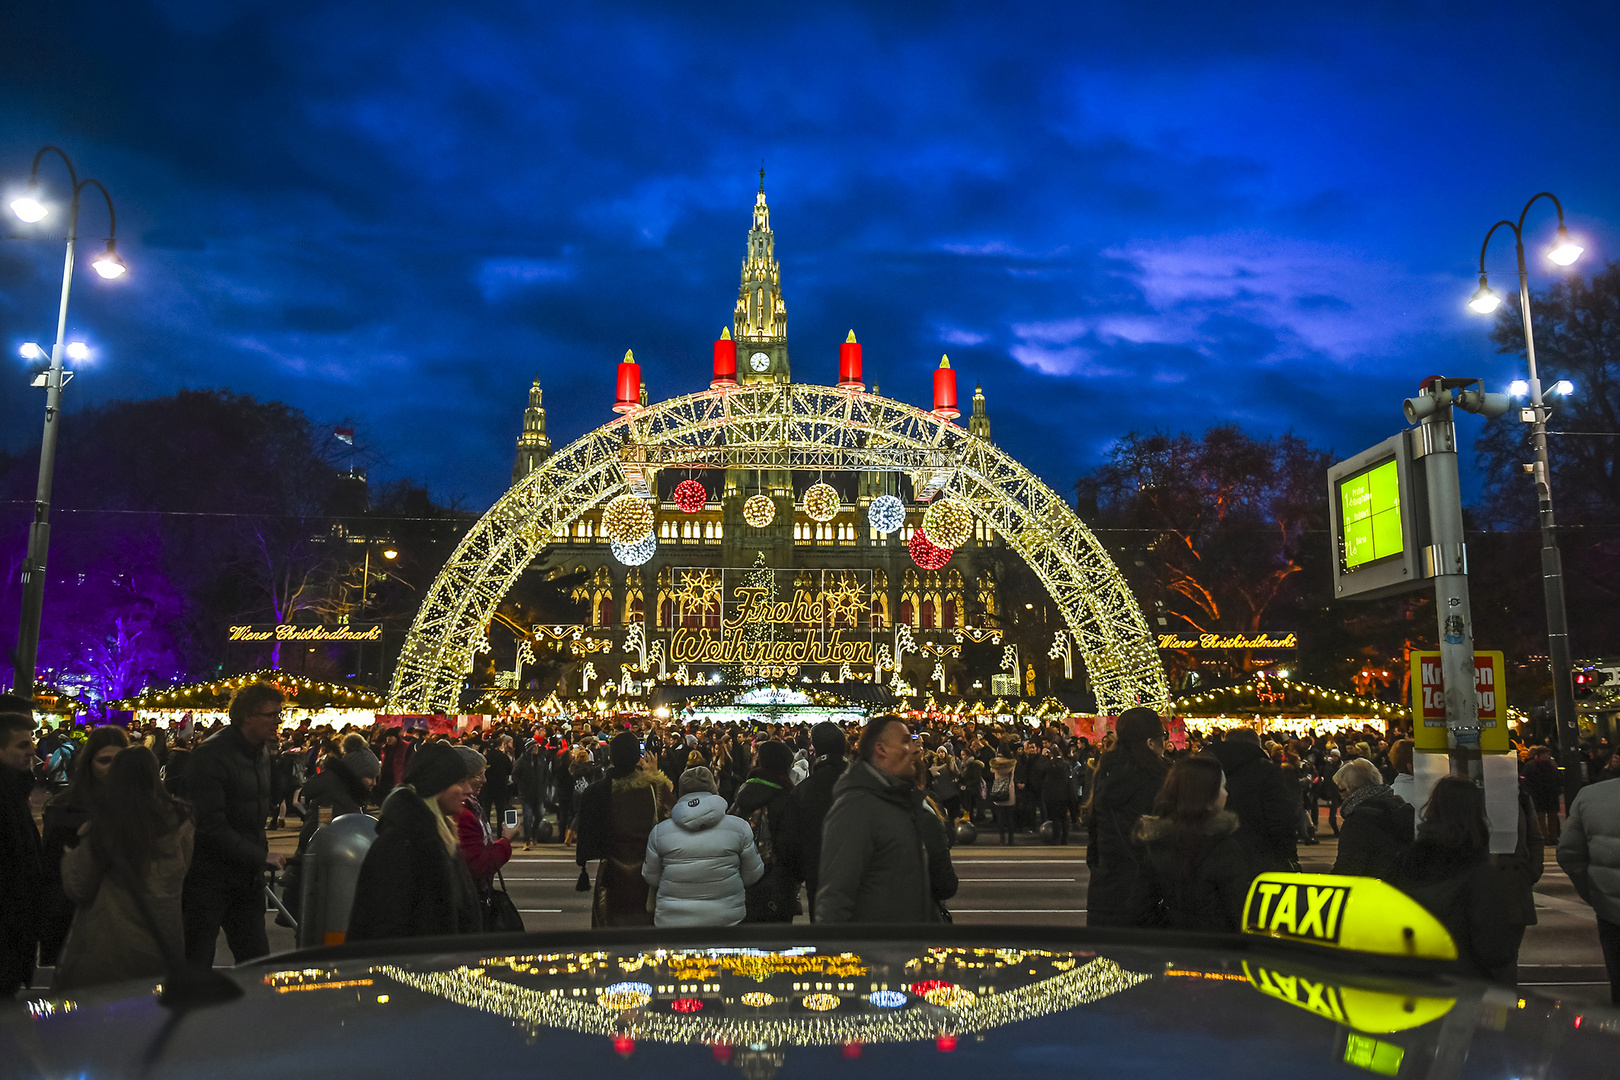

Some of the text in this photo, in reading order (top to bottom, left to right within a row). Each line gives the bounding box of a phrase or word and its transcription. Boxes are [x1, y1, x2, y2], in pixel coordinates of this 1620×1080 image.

[723, 587, 824, 629] Frohe
[228, 624, 382, 641] Wiener Christkindlmarkt
[670, 627, 873, 663] Weihnachten
[1158, 633, 1297, 648] Wiener Christkindlmarkt
[1258, 883, 1345, 939] TAXI
